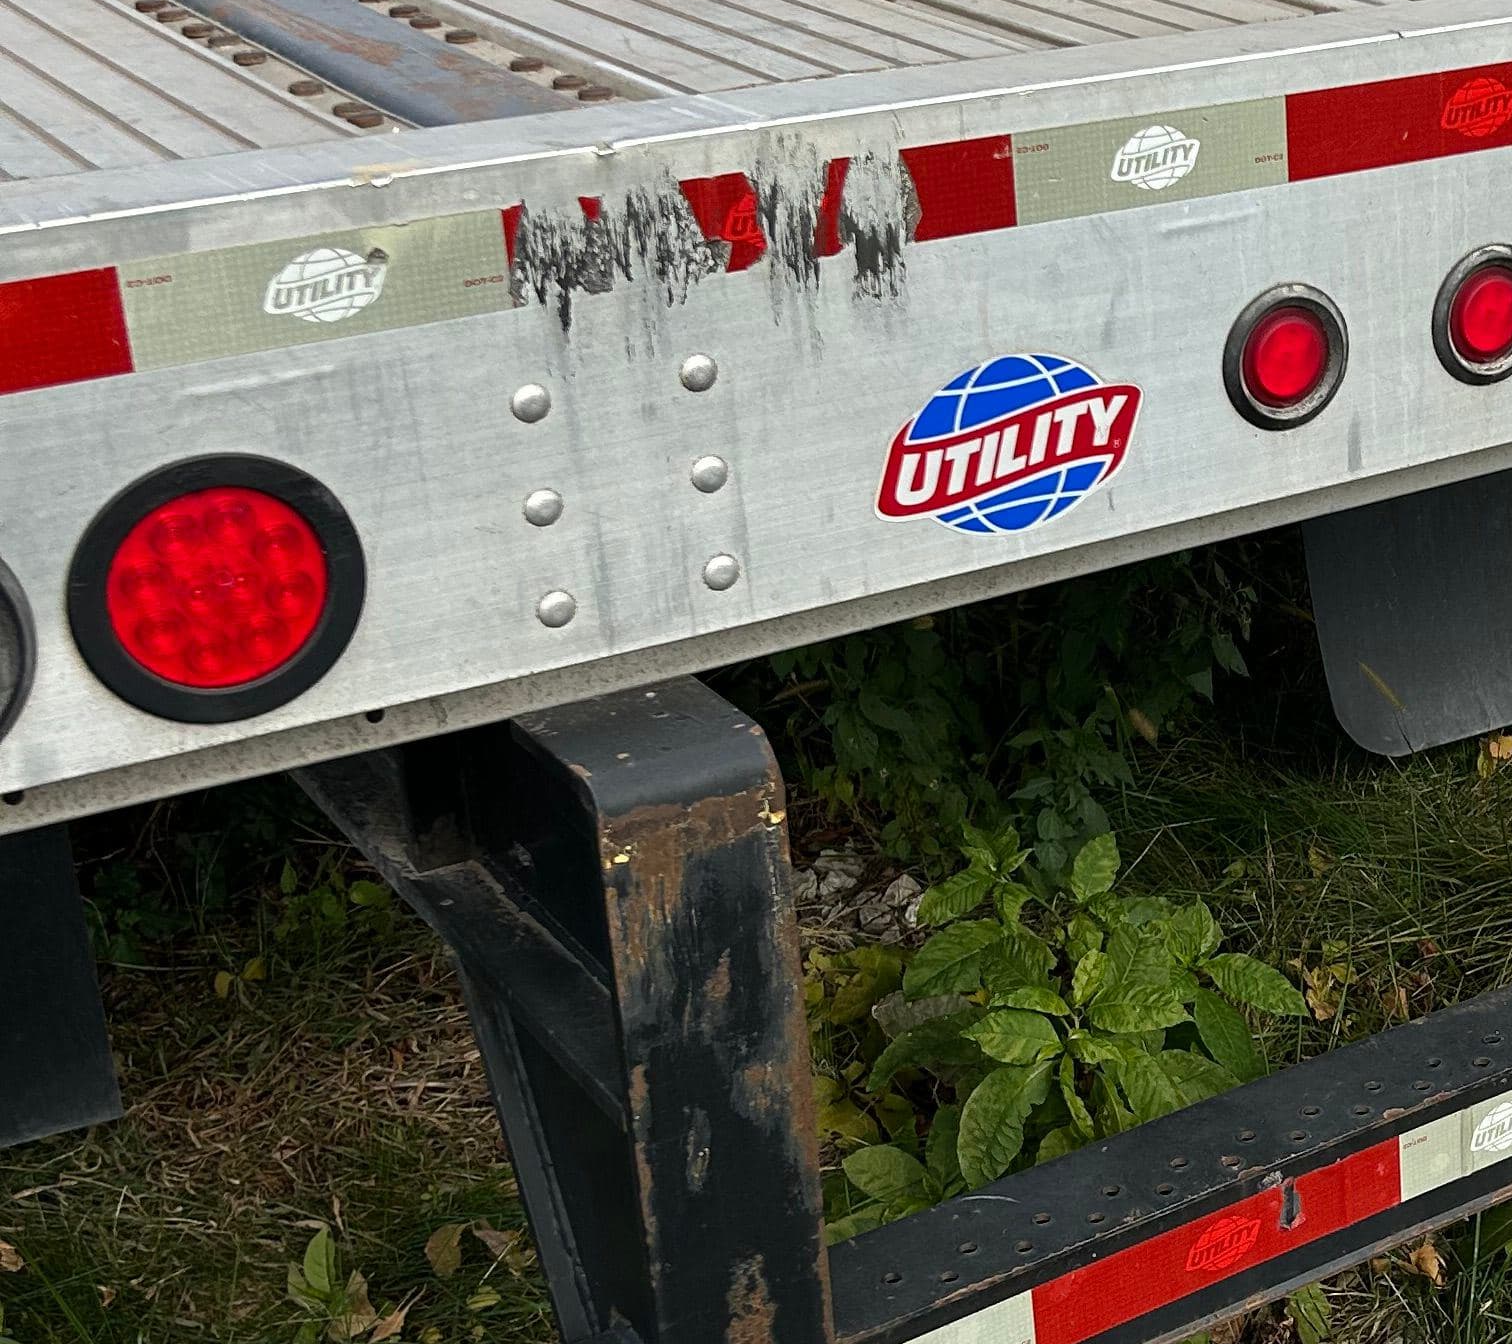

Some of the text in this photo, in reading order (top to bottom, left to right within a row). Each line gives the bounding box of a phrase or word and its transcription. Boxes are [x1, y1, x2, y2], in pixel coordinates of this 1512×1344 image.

[1116, 143, 1196, 177] UTILITY
[272, 265, 383, 310] UTILITY
[901, 393, 1128, 506] UTILITY
[1188, 1222, 1258, 1267] UTILITY
